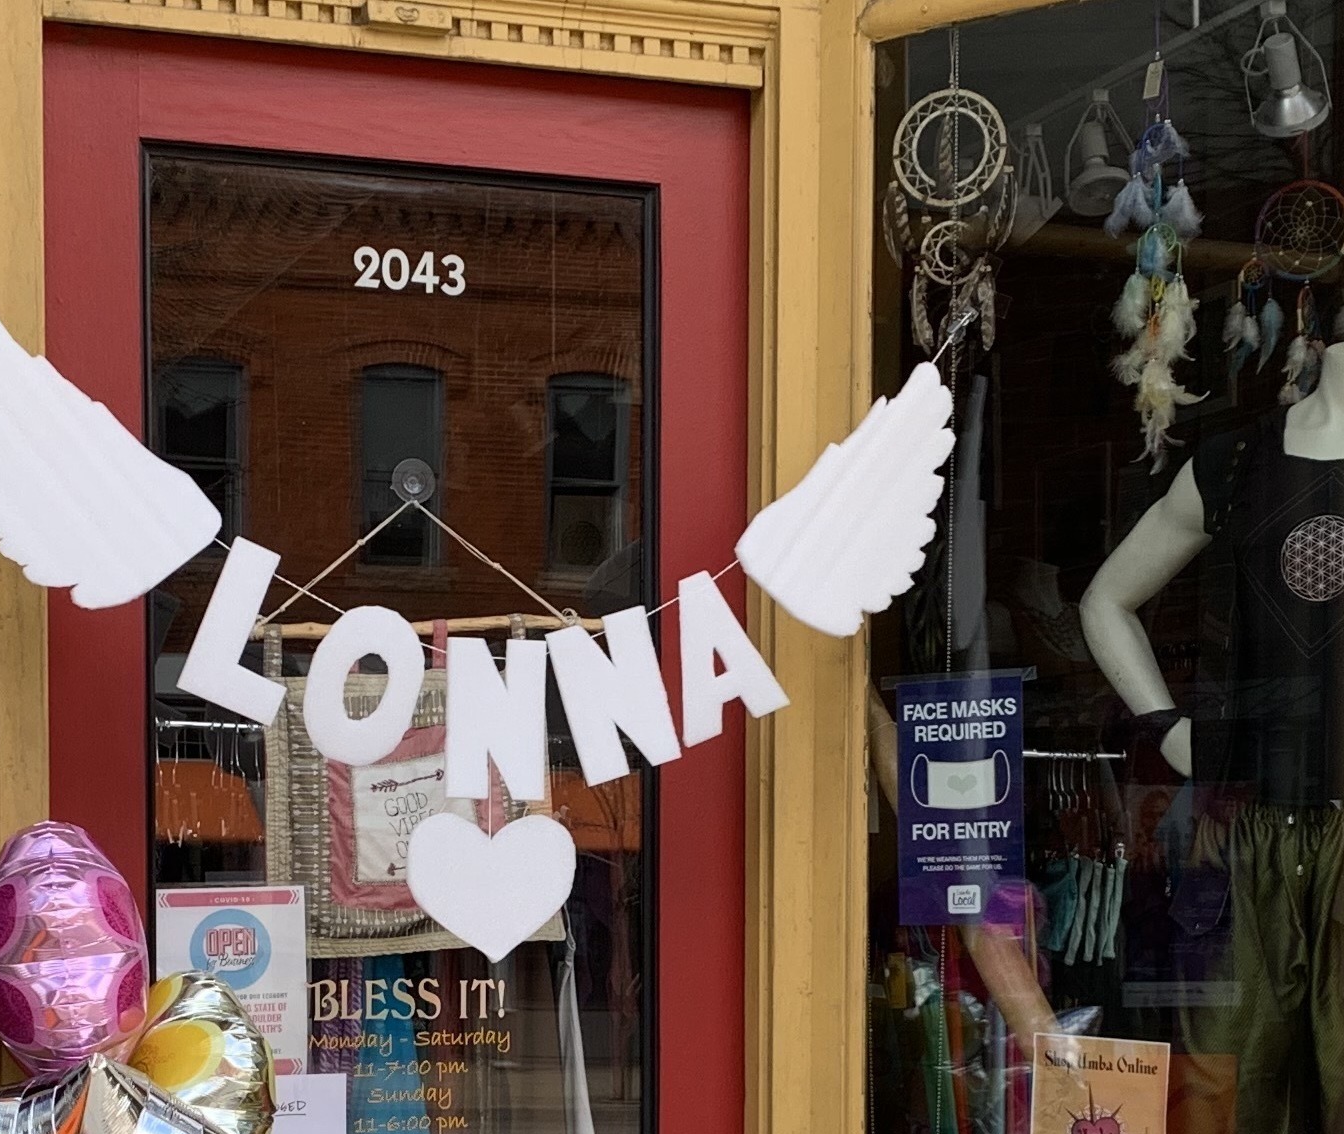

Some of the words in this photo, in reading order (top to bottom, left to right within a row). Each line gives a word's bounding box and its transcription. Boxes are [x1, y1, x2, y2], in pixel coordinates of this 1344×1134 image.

[353, 245, 466, 296] 2043
[176, 535, 791, 800] LONNA
[903, 703, 948, 722] FACE
[951, 697, 1017, 719] MASKS
[914, 721, 1006, 743] REQUIRED
[384, 792, 428, 817] GOOD
[912, 823, 950, 841] FOR
[954, 821, 1011, 840] ENTRY
[206, 928, 256, 956] OPEN
[254, 1003, 276, 1012] STATE
[278, 1003, 288, 1012] OF
[307, 978, 442, 1021] BLESS
[459, 978, 506, 1019] IT!
[252, 1014, 282, 1023] OULDER
[309, 1033, 393, 1056] Monday
[413, 1026, 511, 1052] Saturday
[353, 1060, 431, 1081] 11-7:00
[436, 1061, 468, 1082] pm
[1077, 1053, 1113, 1072] Umba
[1116, 1056, 1158, 1075] Online
[367, 1083, 452, 1109] Sunday
[353, 1115, 431, 1134] 11-6:00
